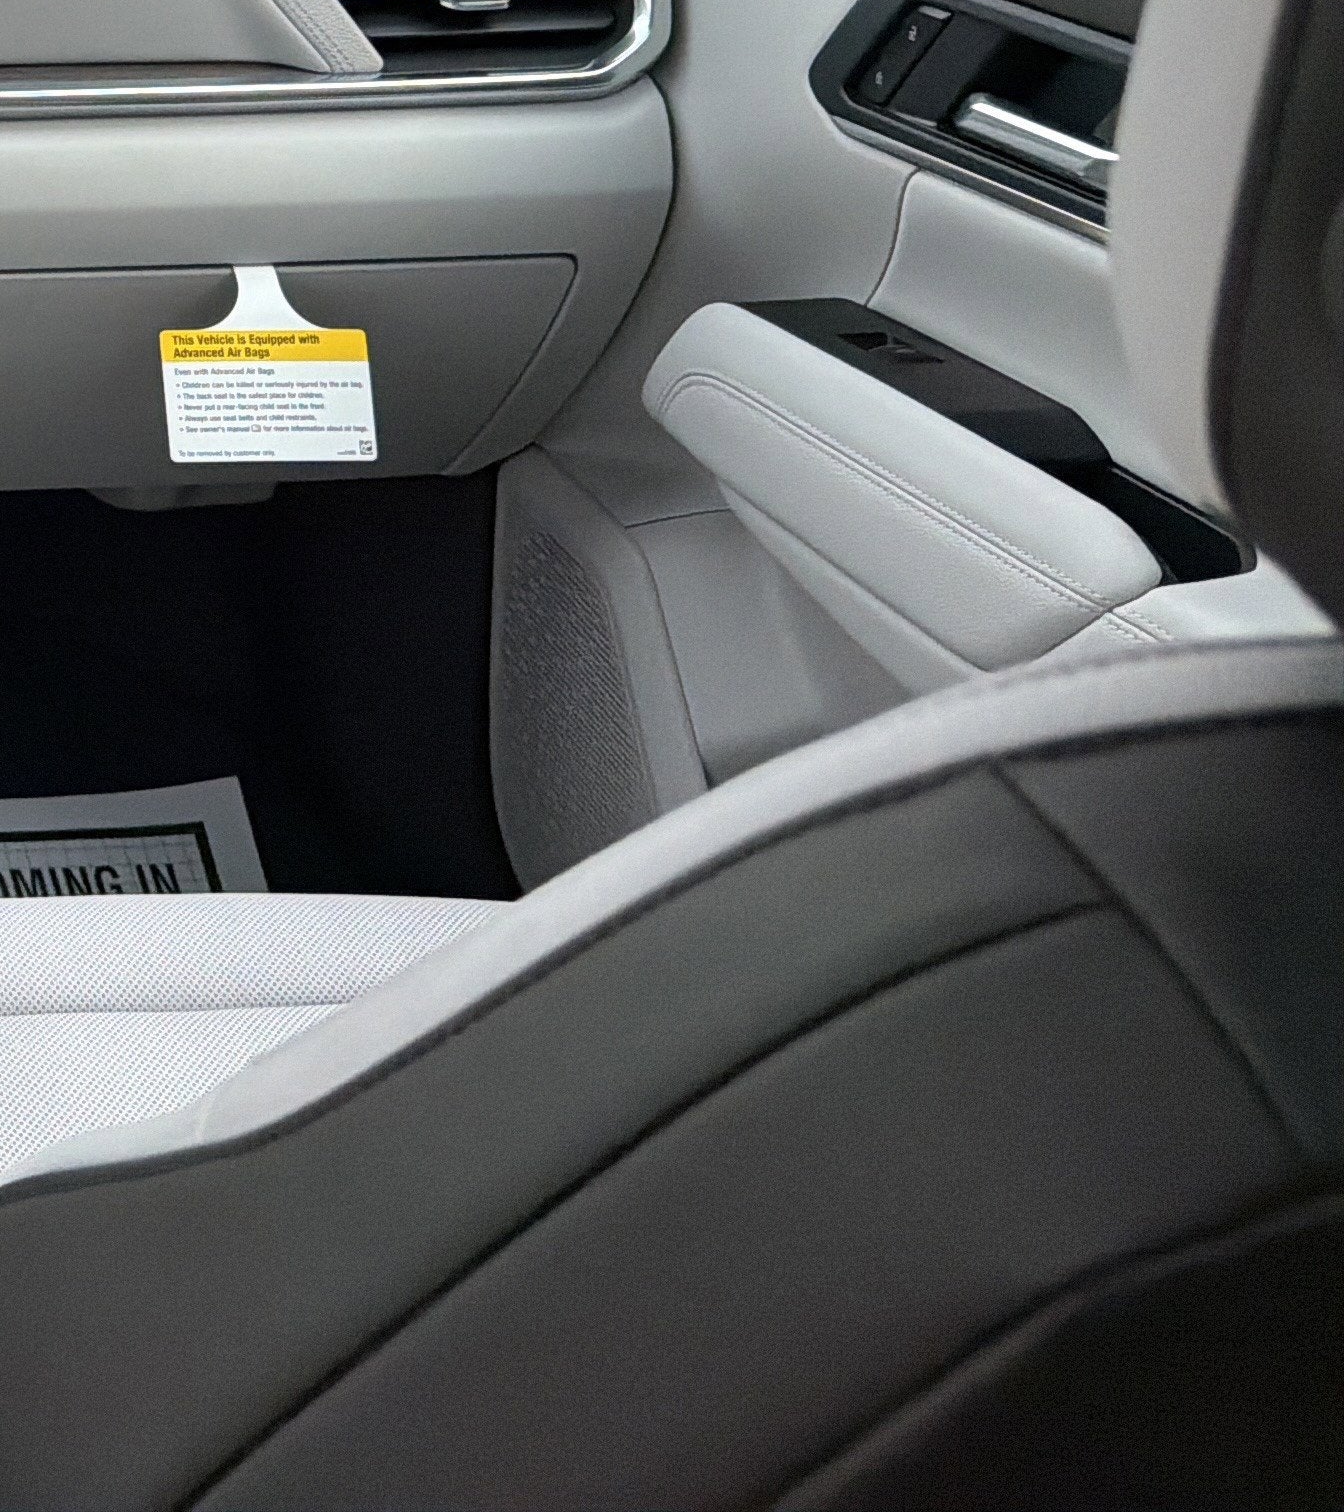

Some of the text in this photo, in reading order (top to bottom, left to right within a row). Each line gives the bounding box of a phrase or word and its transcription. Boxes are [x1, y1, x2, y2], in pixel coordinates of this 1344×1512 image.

[173, 335, 194, 346] This
[197, 334, 235, 345] Vehicle
[248, 334, 295, 347] Equipped
[298, 334, 320, 345] with
[173, 347, 270, 360] Advanced Air Bags
[174, 367, 275, 376] Even with Advanced Air Bags
[134, 863, 182, 895] IN
